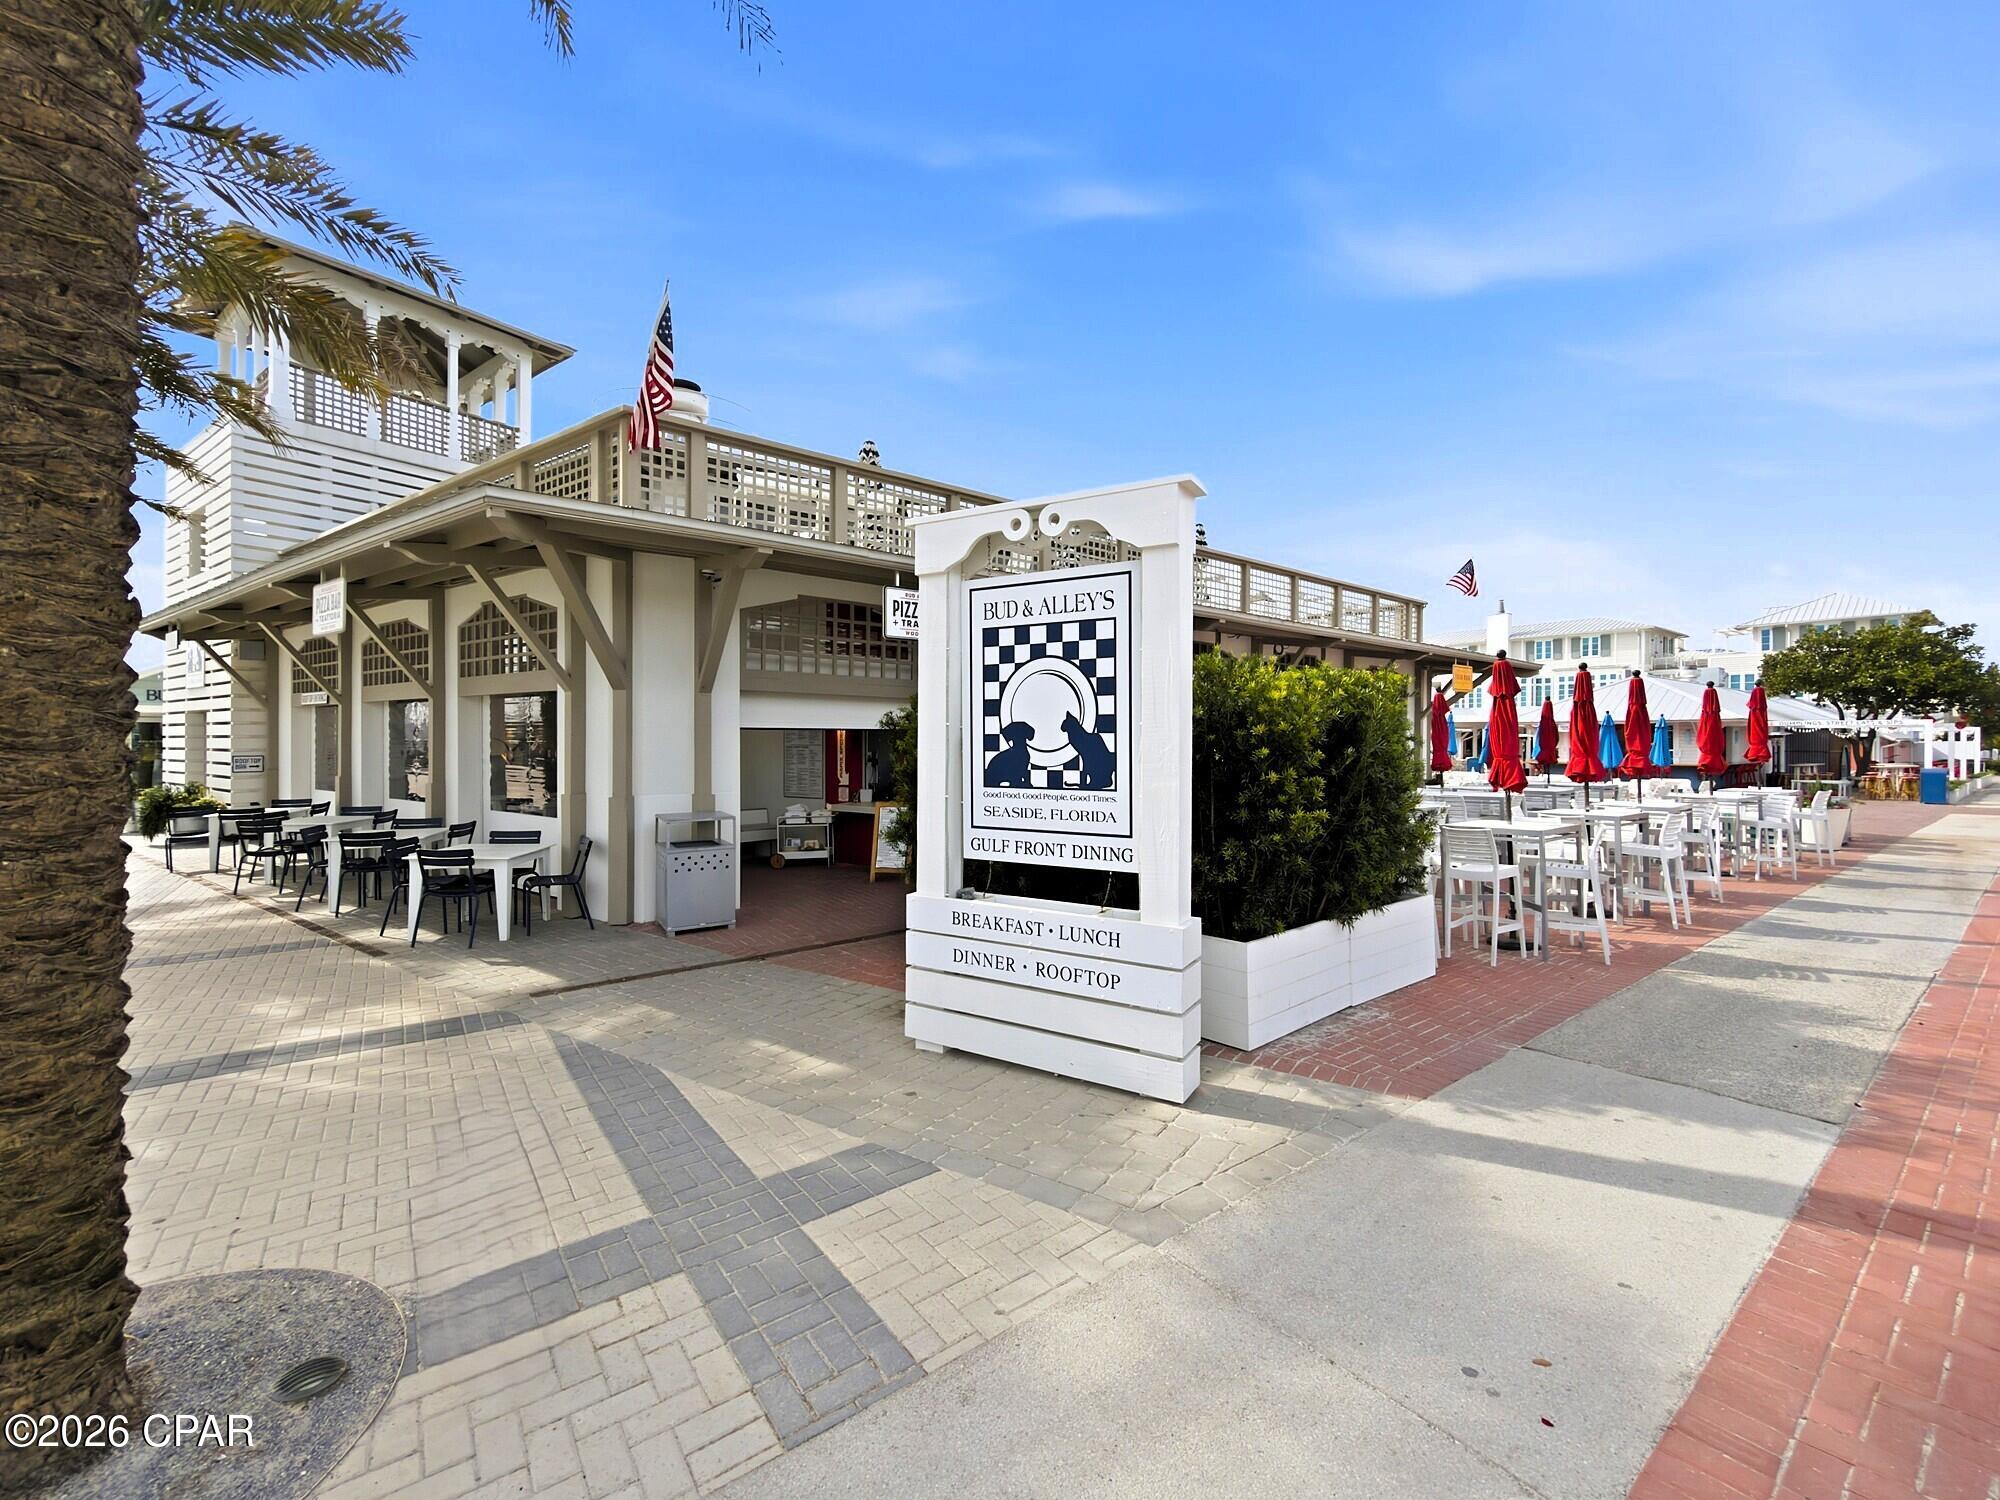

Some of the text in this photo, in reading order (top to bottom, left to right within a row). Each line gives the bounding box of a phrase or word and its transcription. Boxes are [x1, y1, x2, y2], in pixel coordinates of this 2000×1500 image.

[892, 599, 919, 619] PIZZ
[983, 589, 1116, 621] BUD & ALLEY'S
[901, 619, 919, 628] TRA
[983, 790, 1002, 799] Good
[1022, 792, 1042, 800] Good
[1069, 794, 1091, 802] Good
[1092, 794, 1118, 803] Times.
[983, 805, 1117, 824] SEASIDE, FLORIDA
[970, 837, 1134, 863] GULF FRONT DINING
[951, 910, 1121, 949] BREAKFAST LUNCH
[953, 948, 1121, 990] DINNER ROOFTOP
